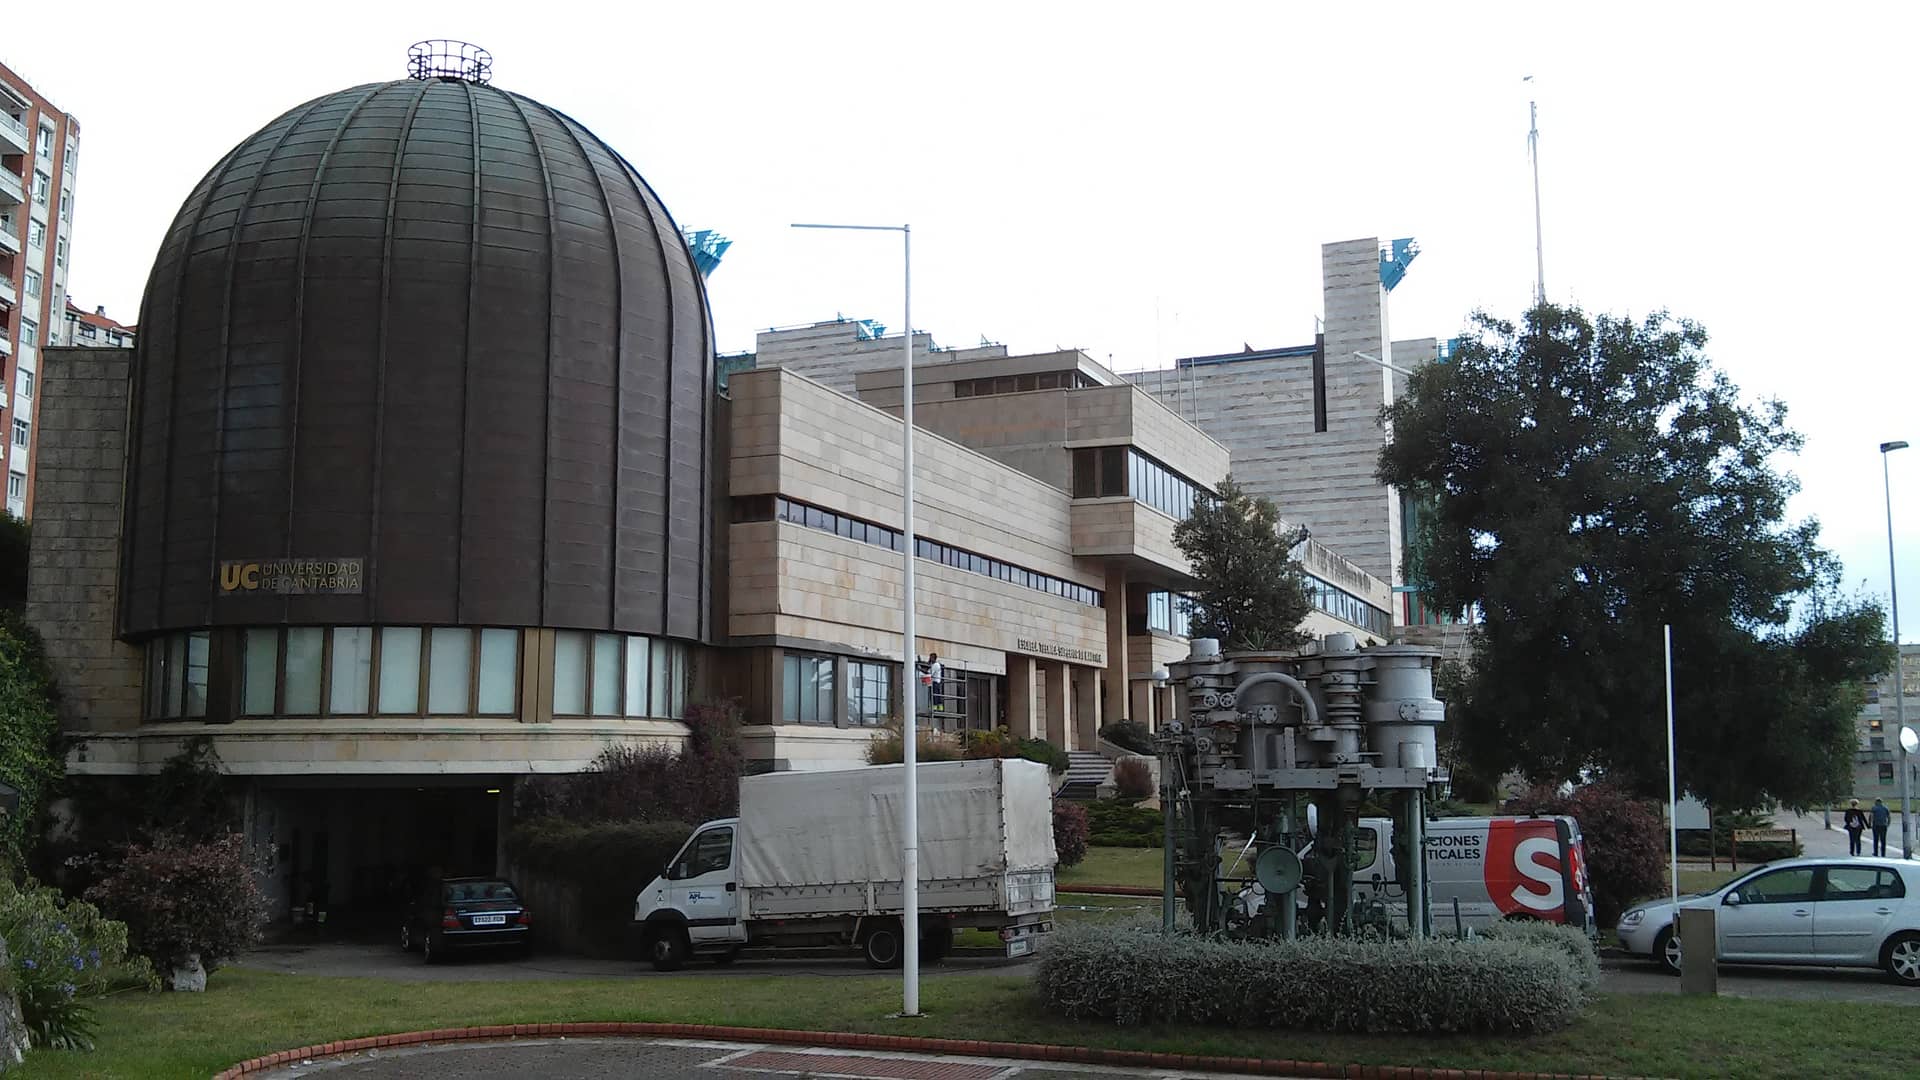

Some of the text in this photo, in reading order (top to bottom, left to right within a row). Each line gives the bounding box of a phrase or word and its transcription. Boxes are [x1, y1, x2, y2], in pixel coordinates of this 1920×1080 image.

[263, 561, 360, 576] UNIVERSIDAD
[220, 563, 259, 591] UC
[262, 576, 359, 590] DE CANTABRIA
[1428, 835, 1480, 847] CIONES
[1427, 848, 1481, 860] TICALES
